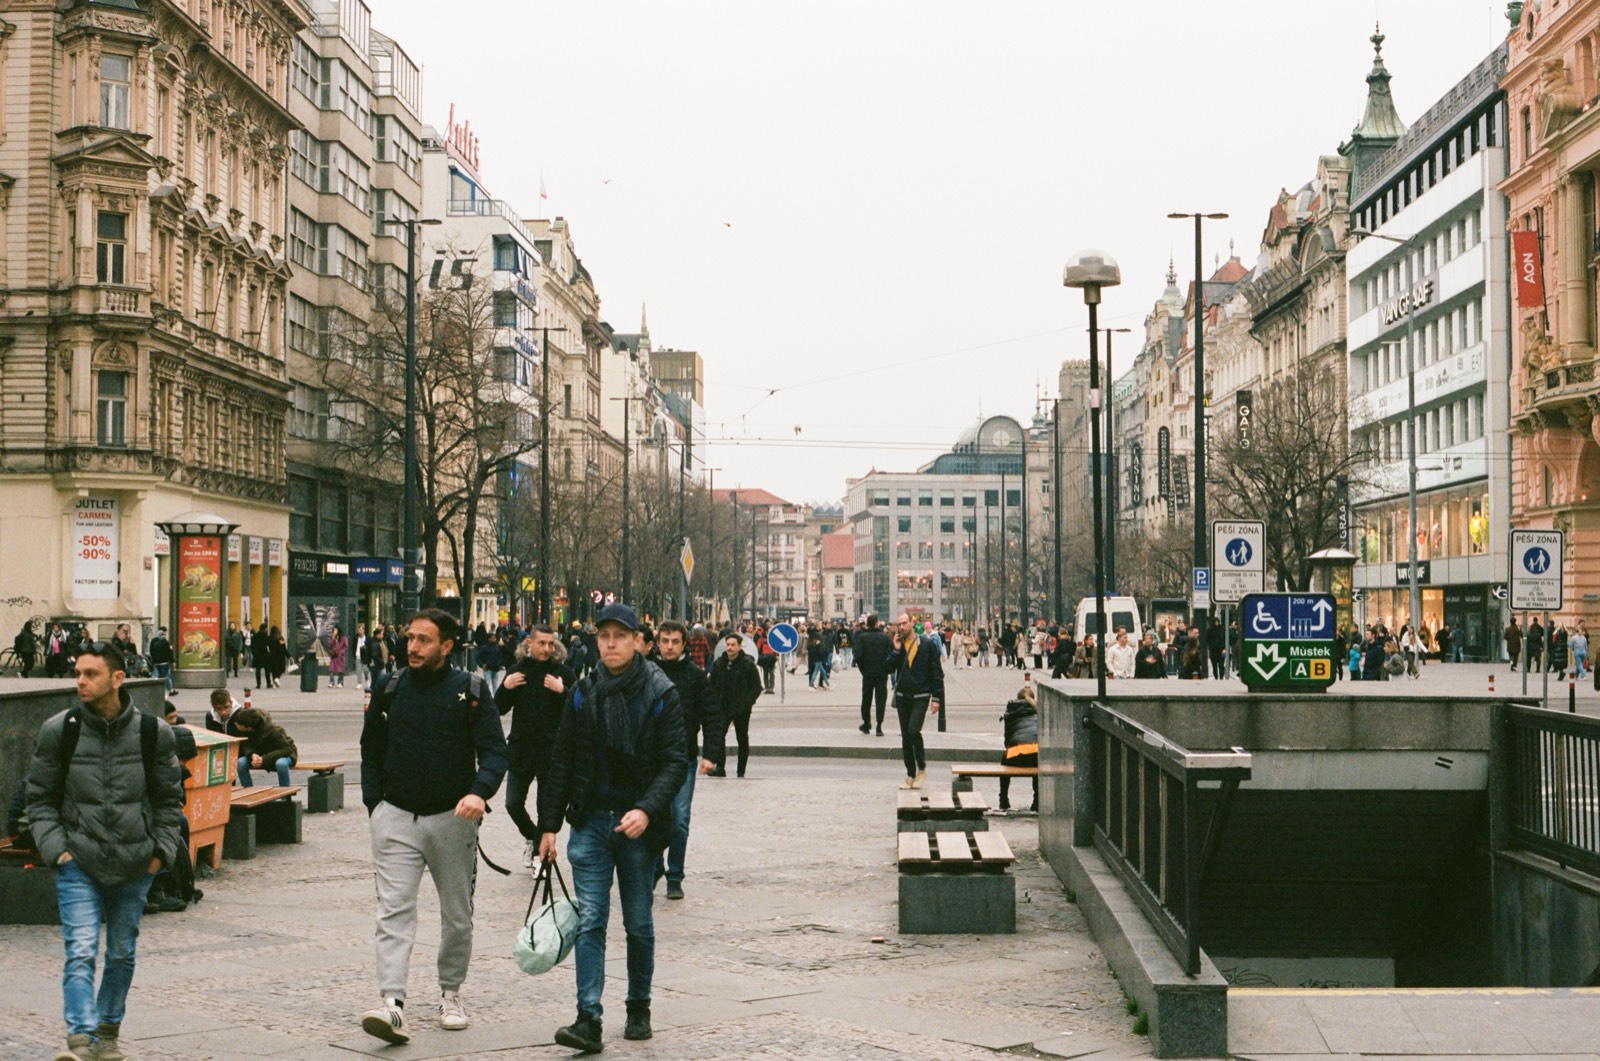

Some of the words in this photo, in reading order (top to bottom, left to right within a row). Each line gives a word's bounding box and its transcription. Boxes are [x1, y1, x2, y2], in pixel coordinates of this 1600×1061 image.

[1523, 252, 1536, 284] AON
[1380, 298, 1399, 325] VAN
[78, 511, 112, 519] CARMEN
[1217, 524, 1236, 534] PĚŠÍ
[1238, 525, 1259, 534] ZÓNA
[78, 535, 111, 547] -50%
[1516, 534, 1534, 544] PĚŠÍ
[1536, 535, 1558, 544] ZÓNA
[78, 548, 111, 560] -90%
[294, 558, 318, 572] PRINCESS
[1290, 645, 1331, 656] Můstek
[1295, 662, 1308, 676] A
[1314, 662, 1326, 676] B
